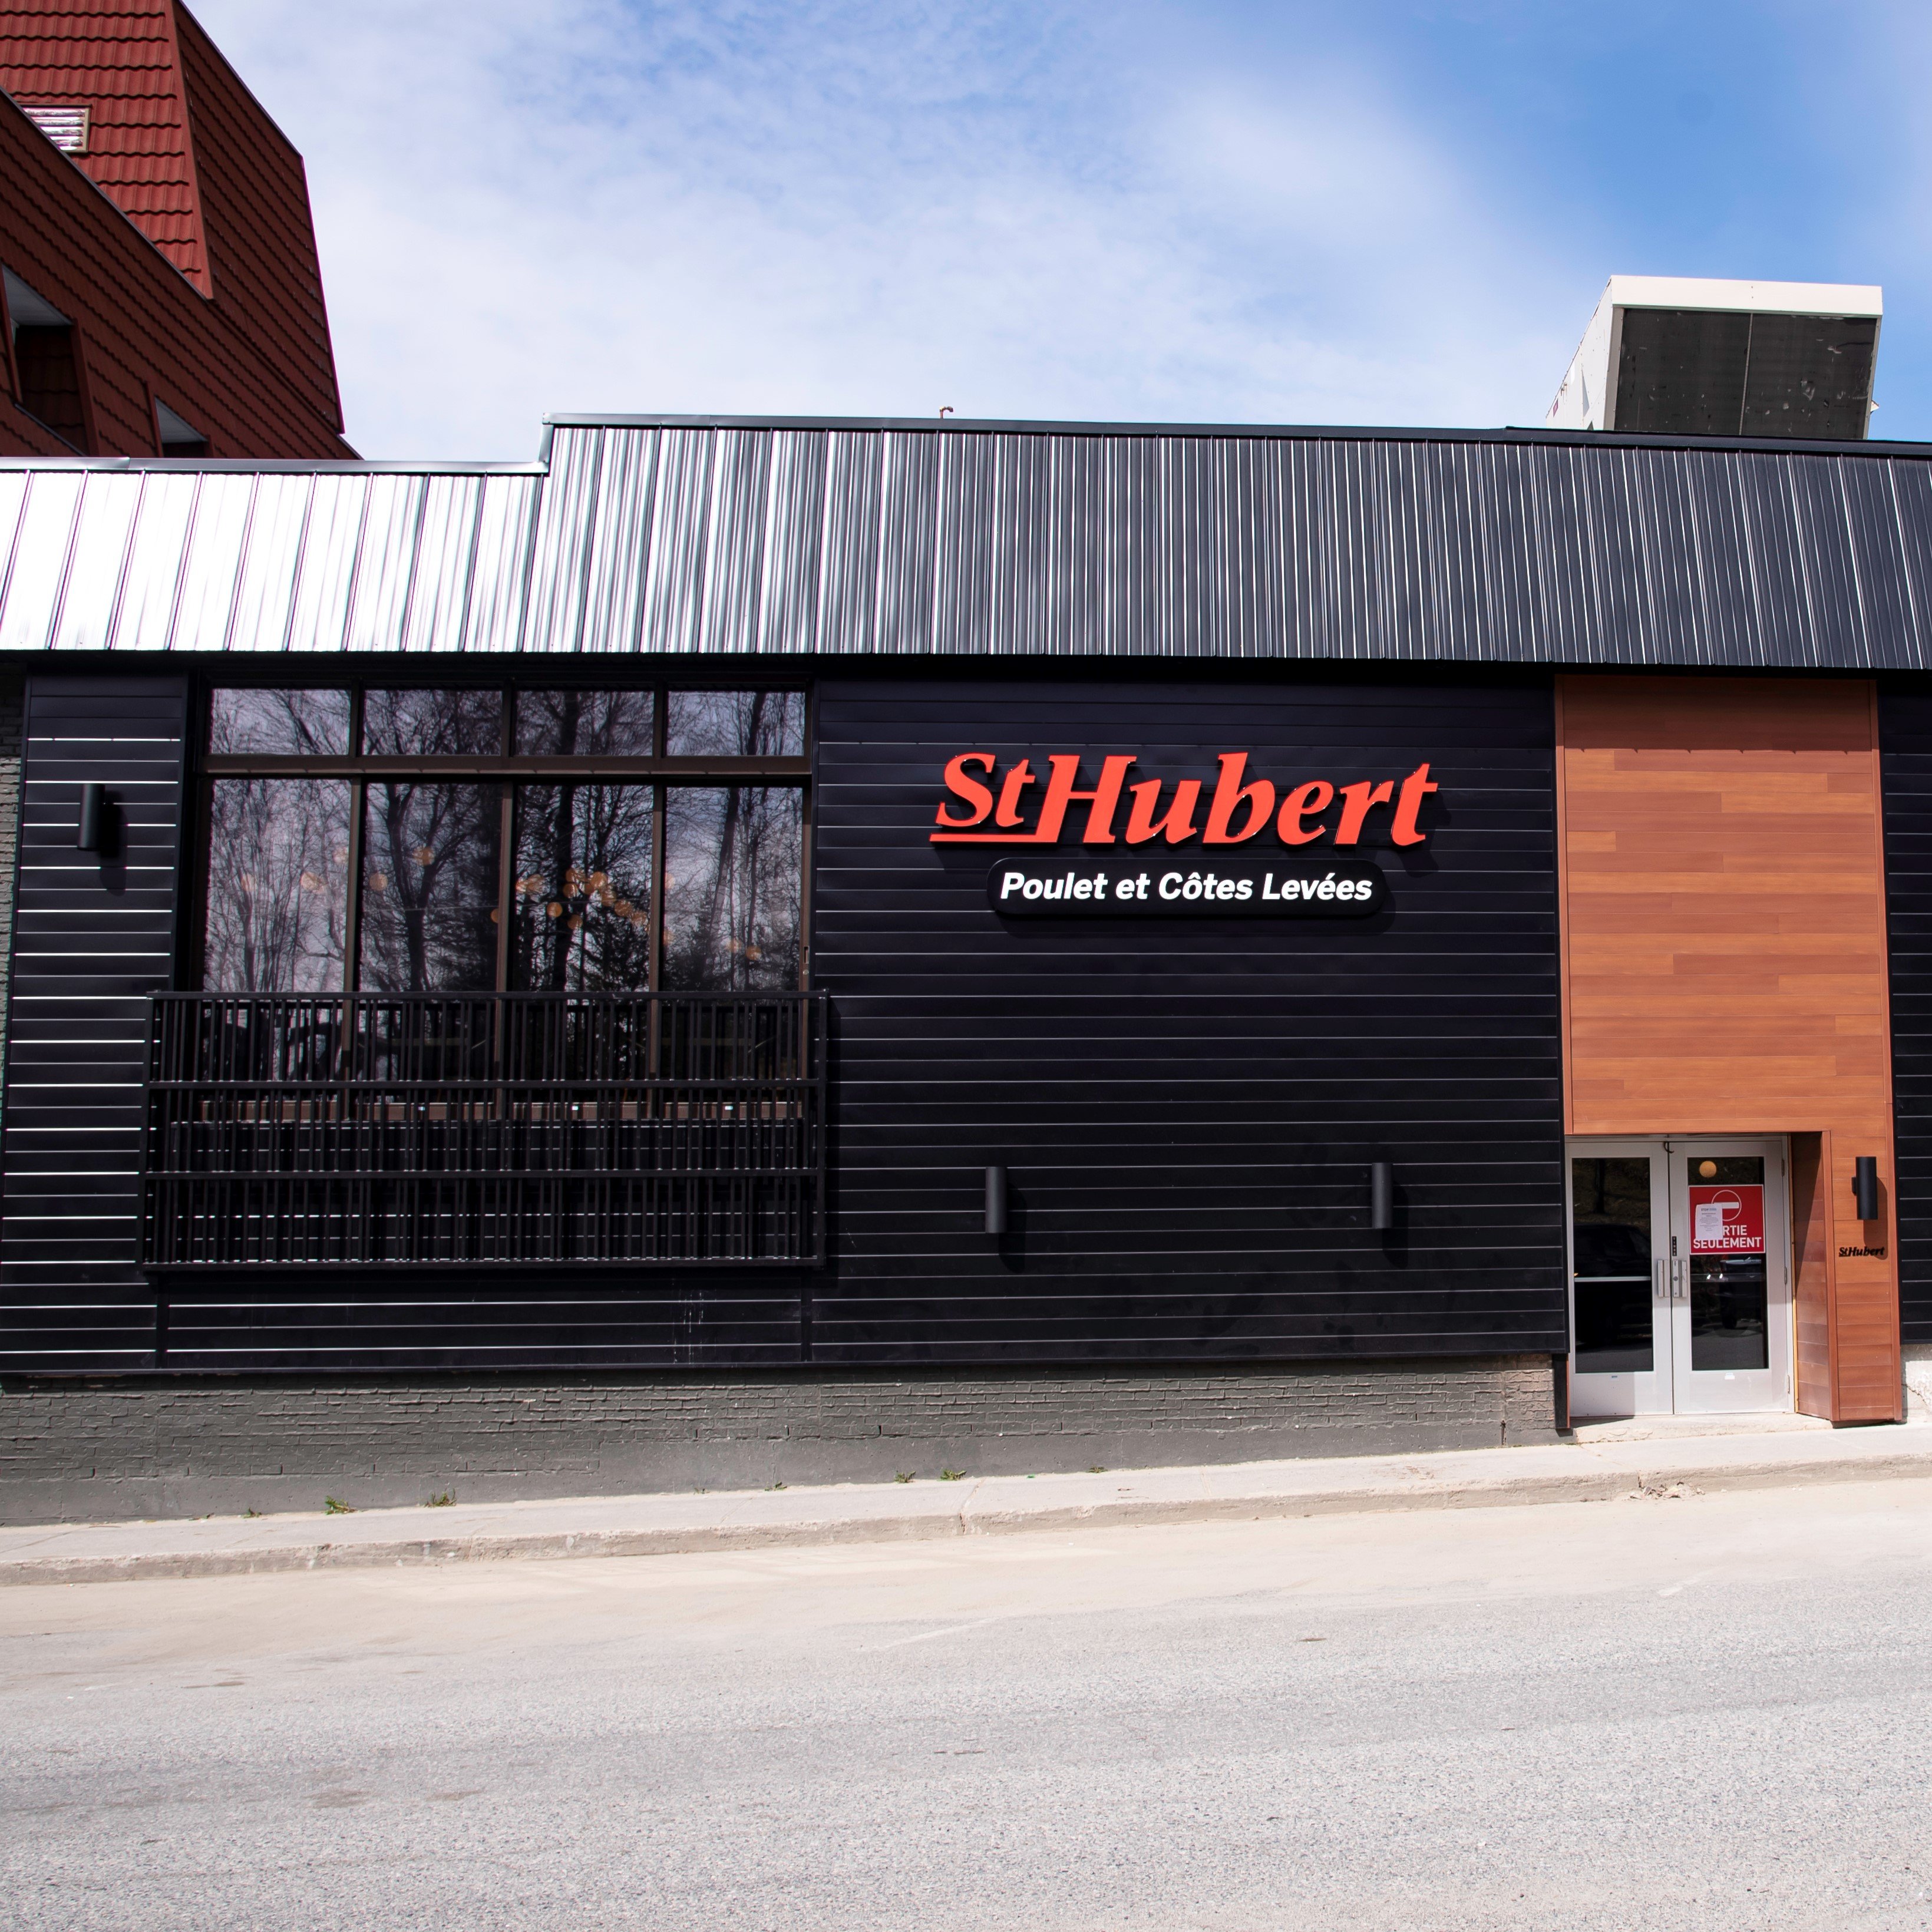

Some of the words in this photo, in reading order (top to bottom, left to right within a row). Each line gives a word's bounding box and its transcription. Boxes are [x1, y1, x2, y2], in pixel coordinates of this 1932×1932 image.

[1000, 872, 1108, 900] Poulet
[1115, 873, 1151, 900] et
[1158, 871, 1253, 900] Côtes
[1262, 872, 1372, 900] Levées
[1723, 1225, 1748, 1236] RTIE
[1693, 1237, 1762, 1249] SEULEMENT
